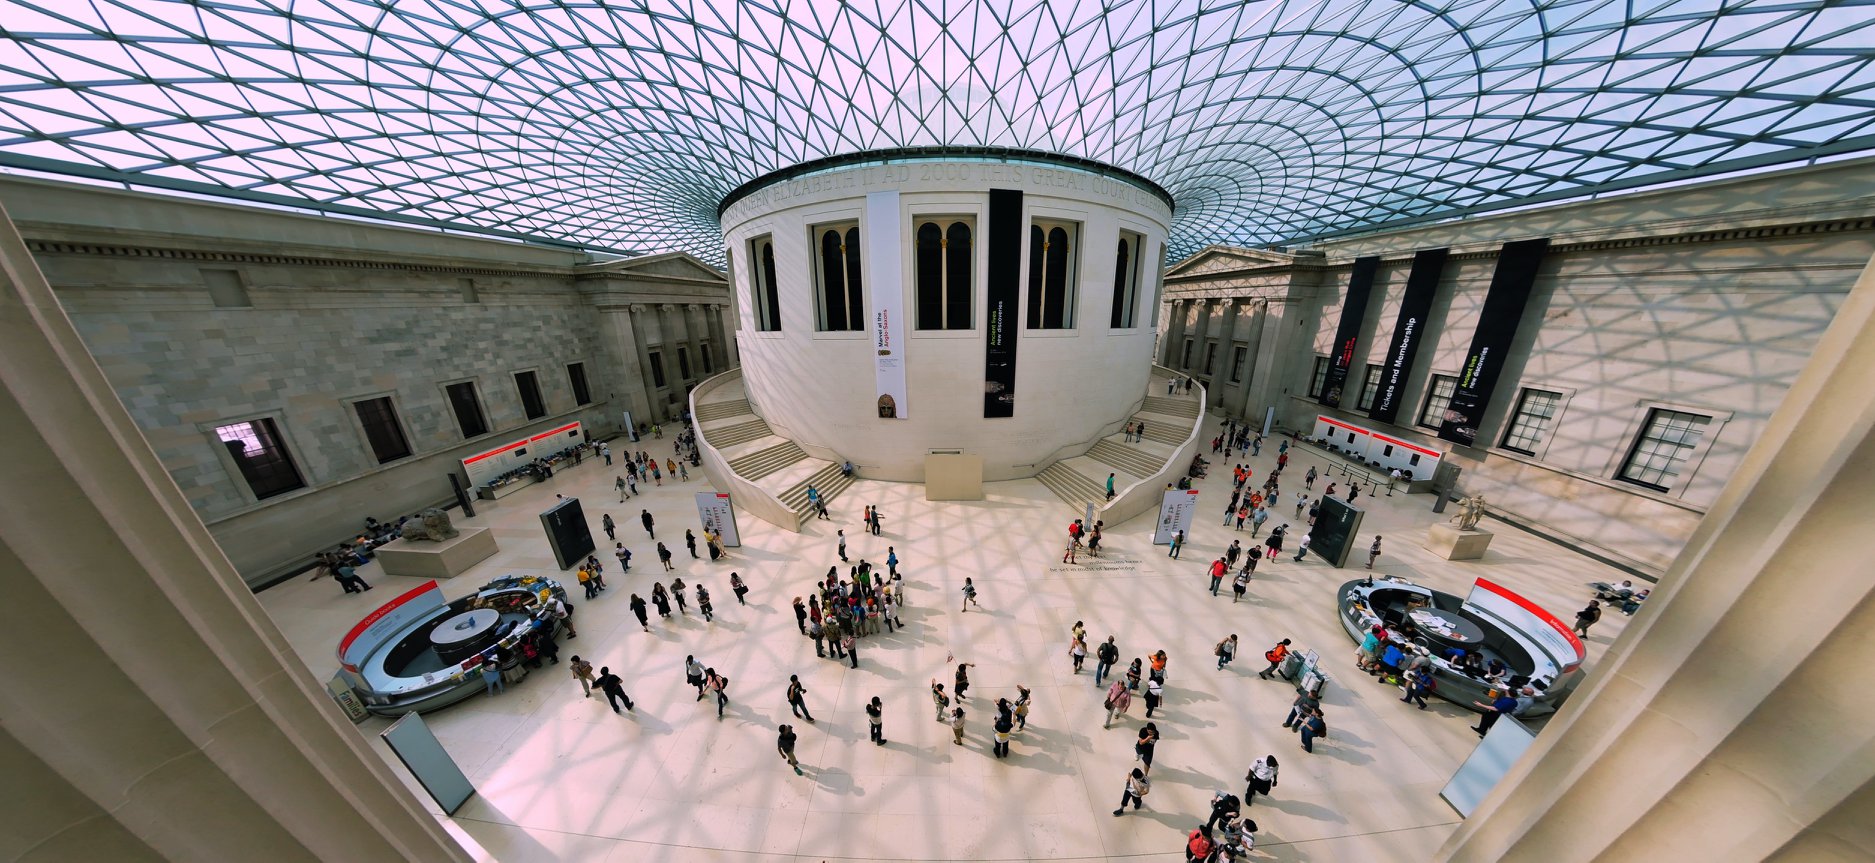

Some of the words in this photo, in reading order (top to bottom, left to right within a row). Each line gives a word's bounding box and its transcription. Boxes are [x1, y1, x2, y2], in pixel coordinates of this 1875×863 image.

[740, 189, 769, 216] QUEEN
[774, 171, 856, 202] ELIZABETH
[882, 165, 910, 183] AD
[919, 163, 970, 181] 2000
[978, 163, 1023, 183] THIS
[1032, 167, 1087, 191] GREAT
[1092, 176, 1133, 203] COURT
[1393, 317, 1416, 367] Membership
[1390, 369, 1400, 384] and
[1461, 368, 1473, 388] Ancient
[1468, 355, 1478, 368] lives
[1469, 377, 1477, 389] new
[1473, 347, 1489, 377] discoveries
[1380, 385, 1395, 411] Tickets
[339, 690, 362, 717] Families
